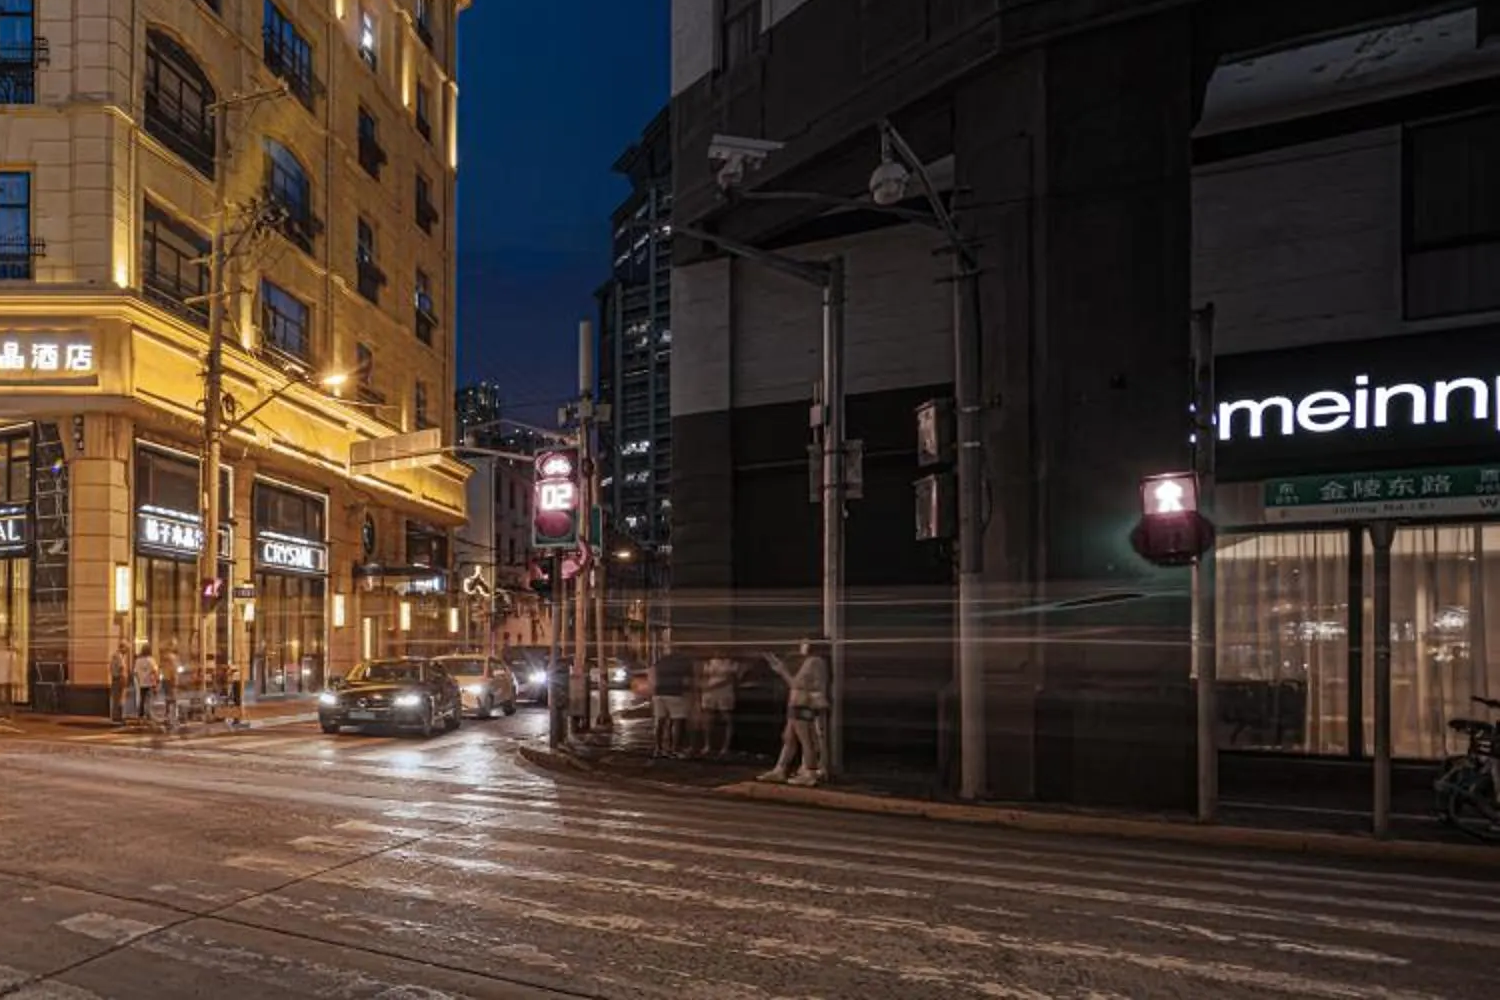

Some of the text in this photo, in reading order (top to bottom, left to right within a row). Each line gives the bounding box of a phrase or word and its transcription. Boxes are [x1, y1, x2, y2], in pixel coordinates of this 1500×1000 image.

[540, 483, 574, 511] 02
[1319, 474, 1452, 501] 金陵东路
